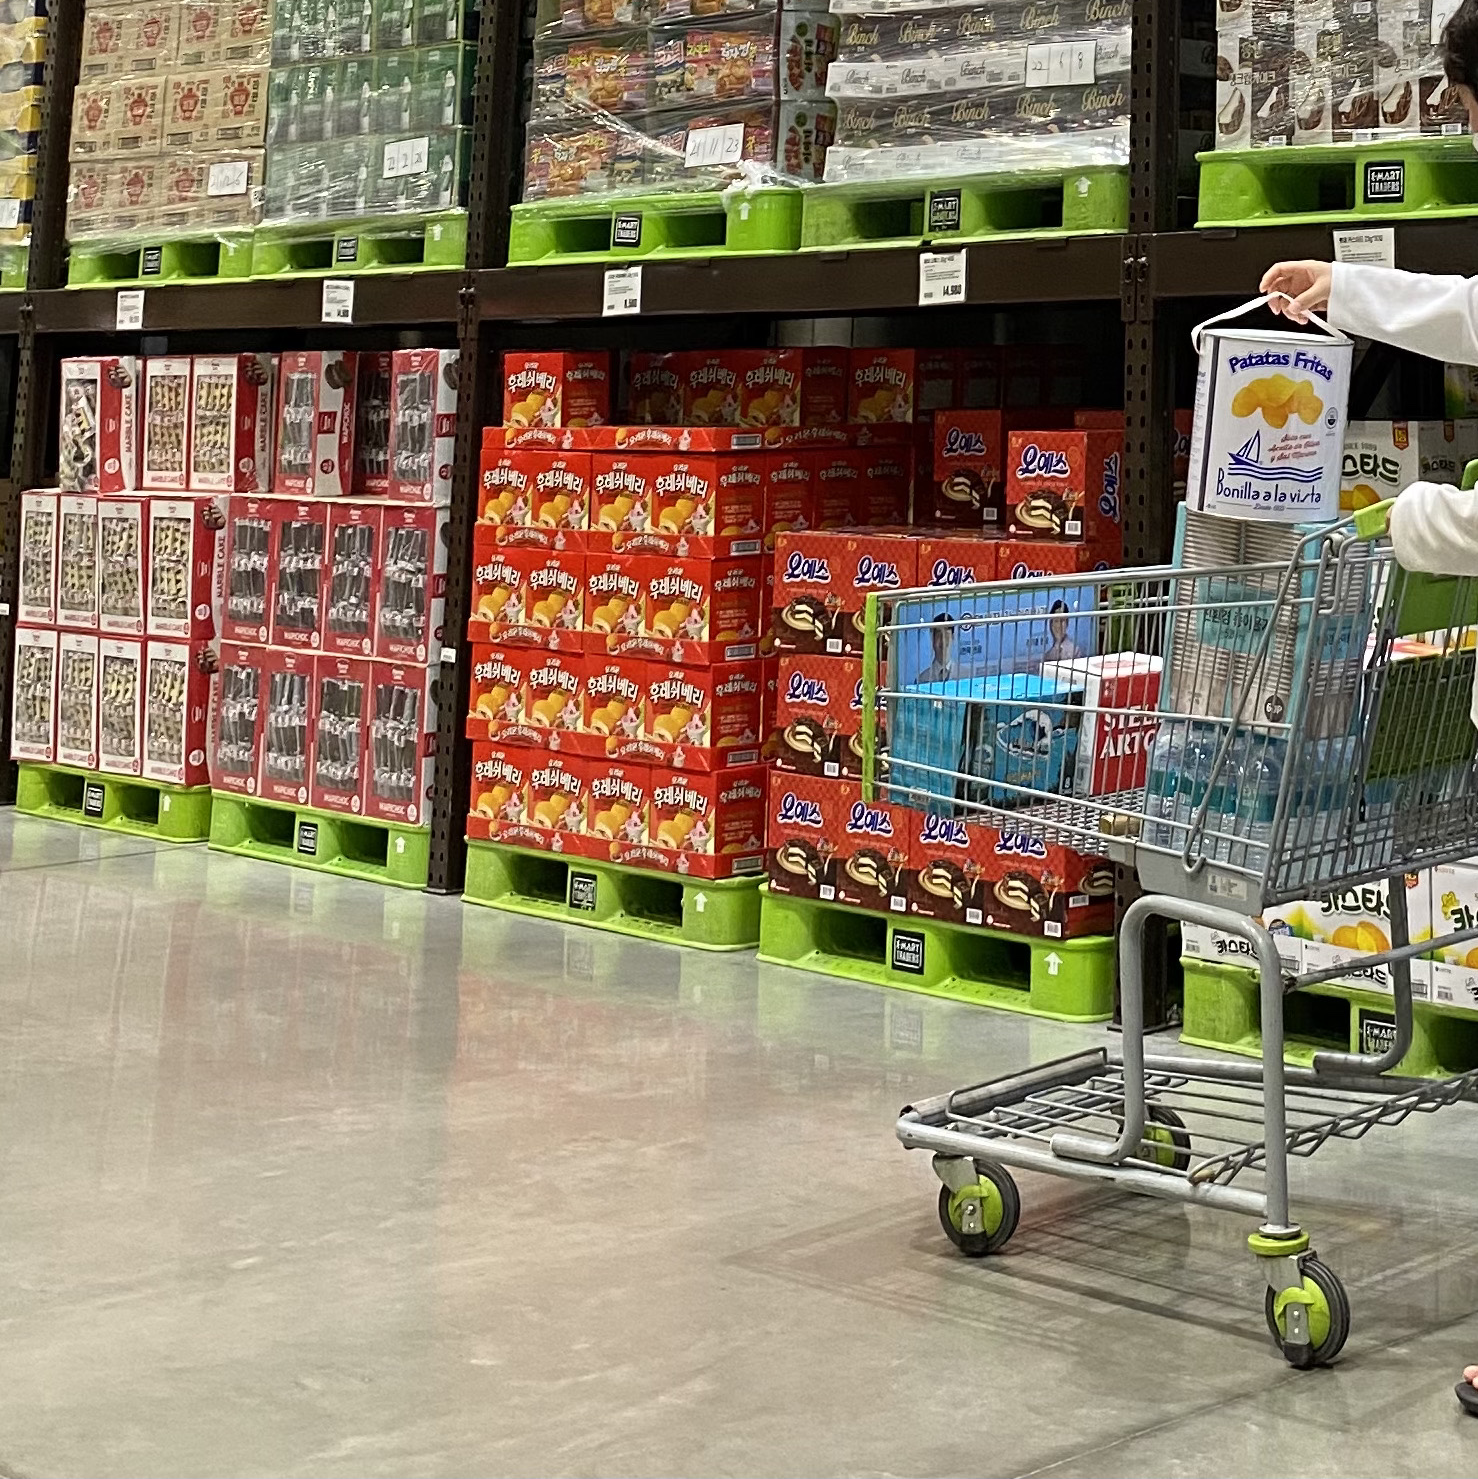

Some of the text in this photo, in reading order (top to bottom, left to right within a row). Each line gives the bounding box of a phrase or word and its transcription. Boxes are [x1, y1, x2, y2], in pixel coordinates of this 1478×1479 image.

[1082, 84, 1126, 111] Binch
[508, 371, 556, 392] 후레쉬베리
[1228, 351, 1333, 382] Patatas Fritas
[943, 427, 987, 458] 오예스
[1016, 444, 1071, 478] 오예스
[596, 472, 646, 496] 후레쉬베리
[656, 473, 708, 498] 후레쉬베리
[1216, 467, 1321, 503] Bonilla a la vista
[785, 552, 831, 584] 오예스
[649, 575, 704, 603] 후레쉬베리
[649, 681, 704, 710] 후레쉬베리
[786, 672, 829, 706] 오예스
[592, 775, 643, 804] 후레쉬베리
[652, 785, 708, 813] 후레쉬베리
[848, 801, 895, 837] 오예스
[920, 811, 969, 848] 오예스
